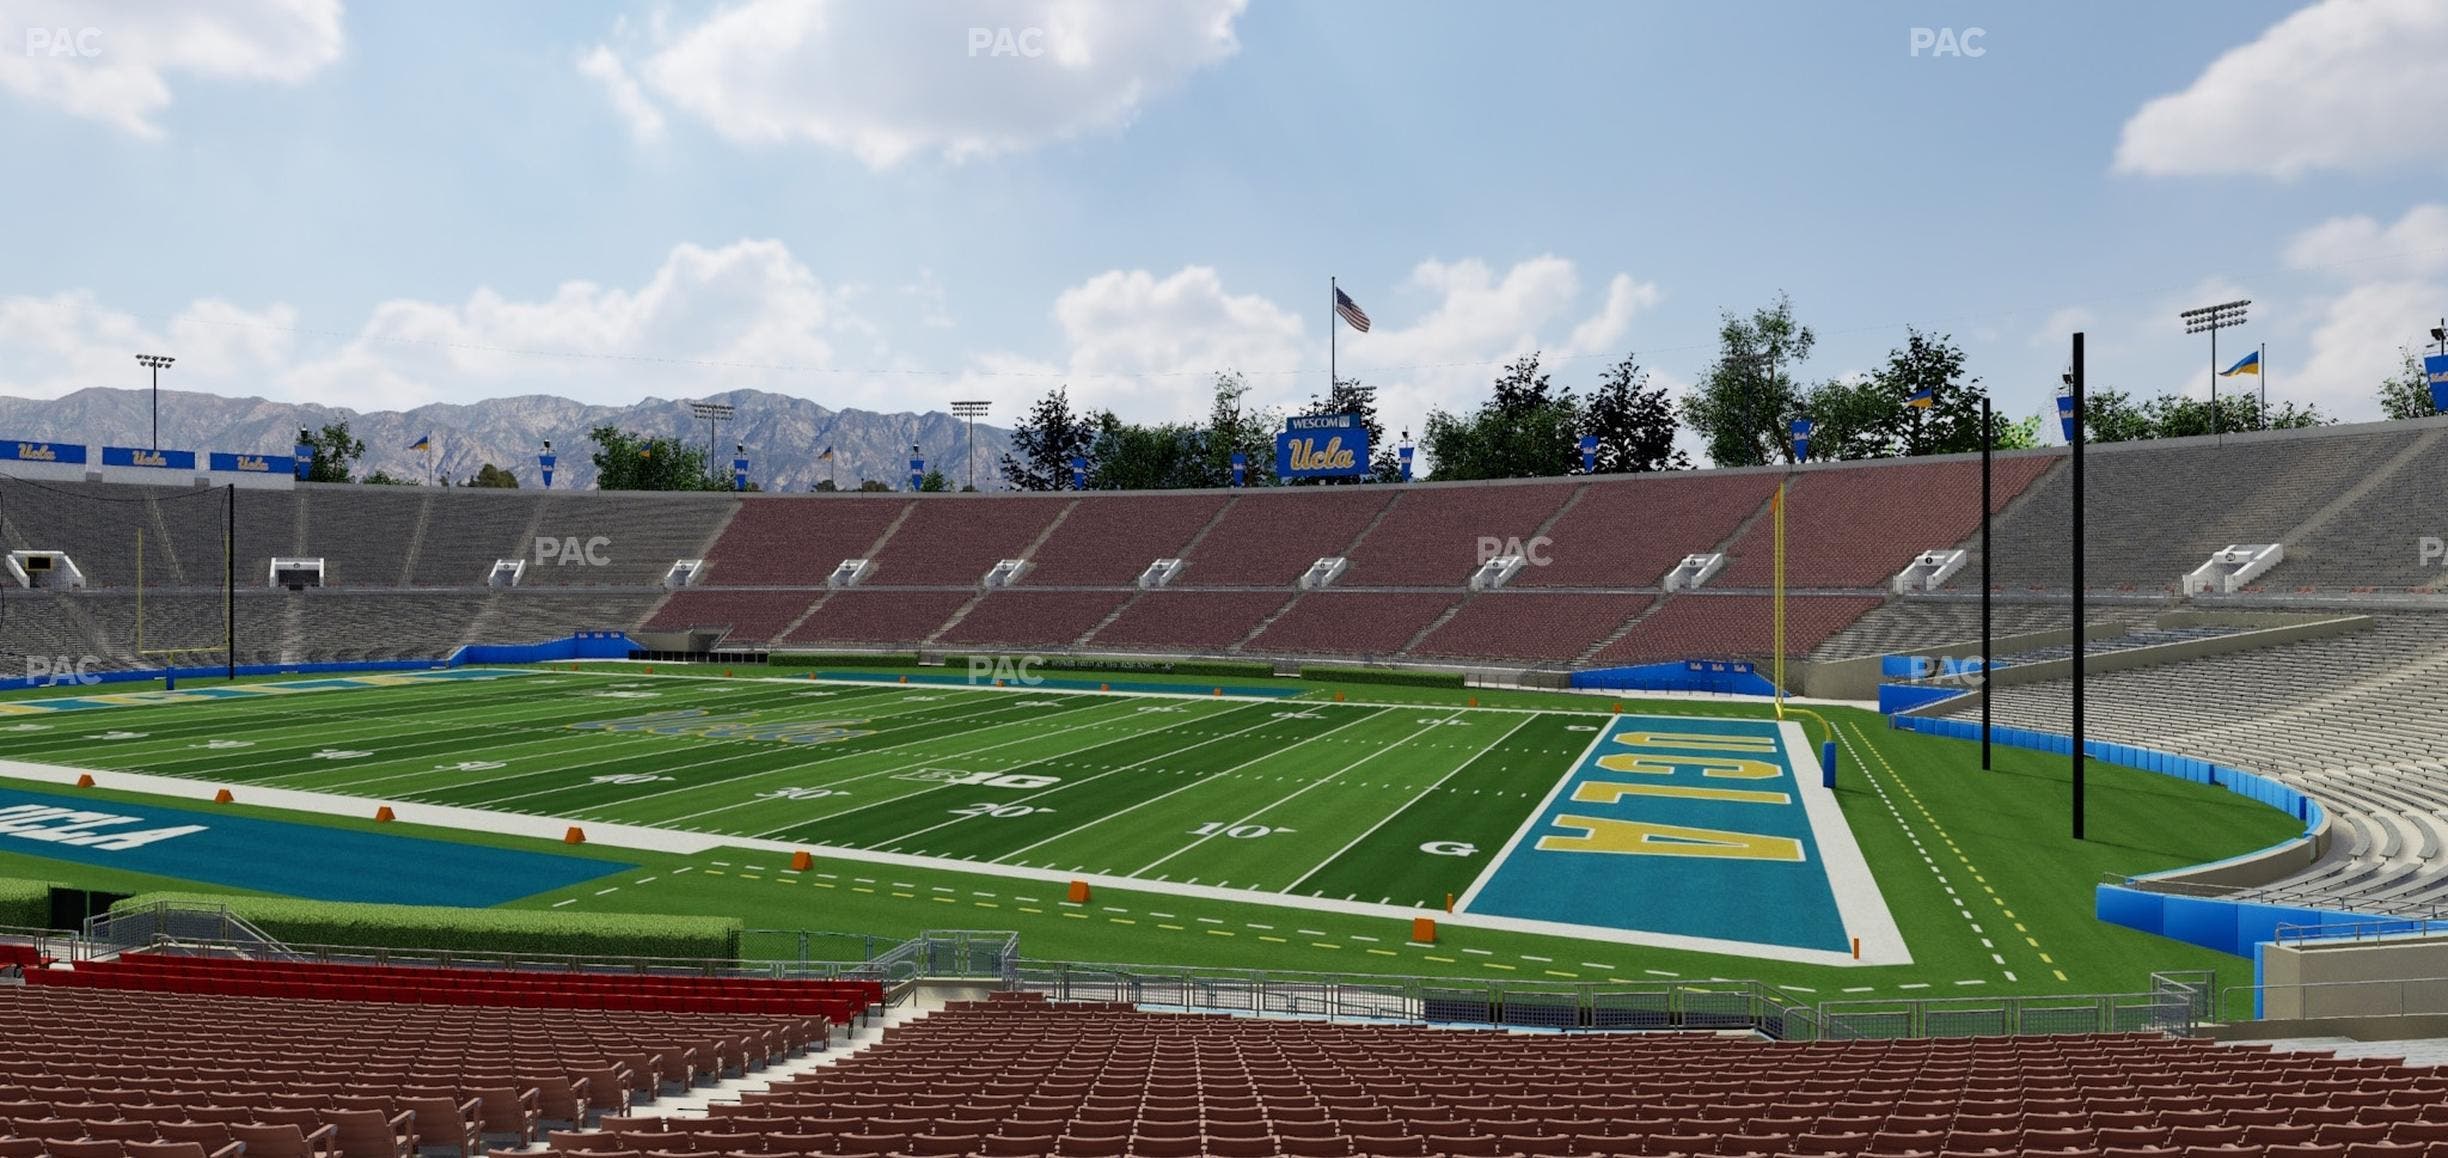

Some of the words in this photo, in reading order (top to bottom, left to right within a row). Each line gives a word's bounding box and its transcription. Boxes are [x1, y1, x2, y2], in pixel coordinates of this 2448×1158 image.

[1292, 418, 1338, 430] WESCOM
[1289, 436, 1356, 470] Ucla
[1534, 731, 1807, 862] UCLA
[946, 802, 1035, 818] 20
[1185, 821, 1272, 839] 10
[1418, 840, 1480, 857] G
